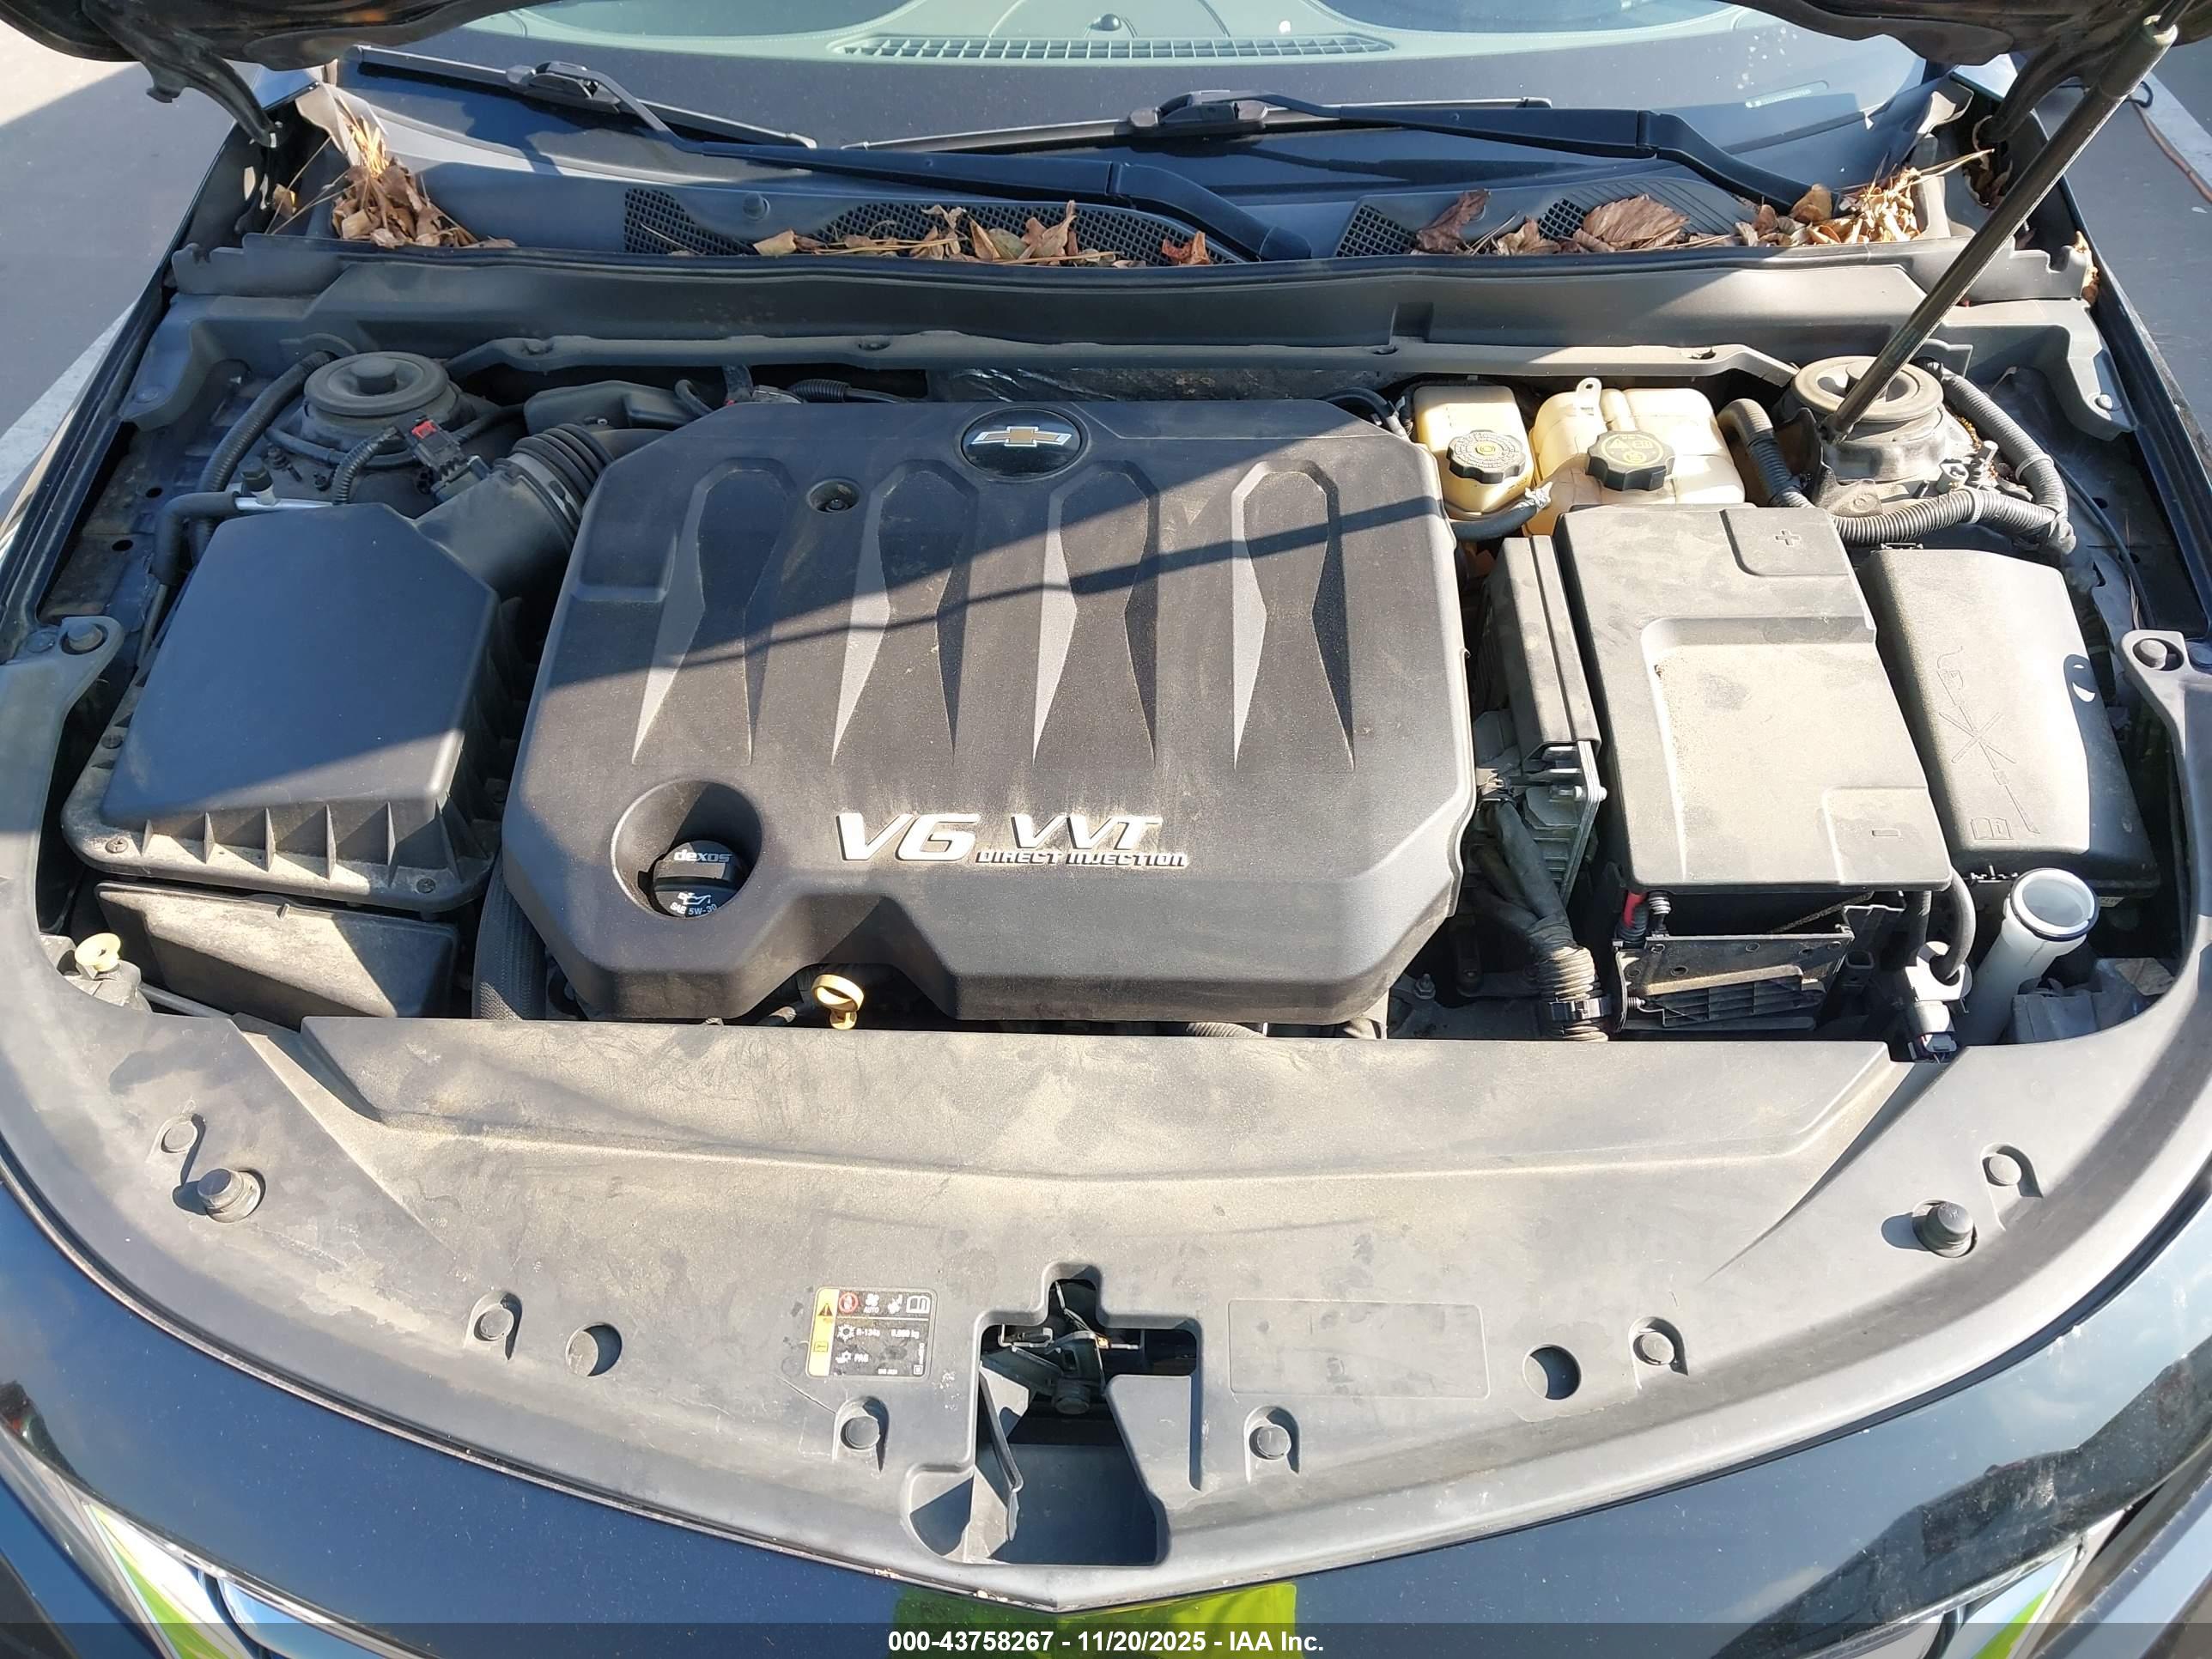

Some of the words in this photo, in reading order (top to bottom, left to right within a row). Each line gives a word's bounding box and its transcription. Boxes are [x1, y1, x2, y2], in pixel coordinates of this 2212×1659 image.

[836, 811, 981, 862] V6
[1010, 813, 1164, 851] VVT
[673, 849, 732, 862] dexos
[975, 851, 1065, 865] DIRECT
[1066, 852, 1188, 867] INJECTION
[670, 902, 687, 915] SAE
[688, 903, 717, 915] 5W-30
